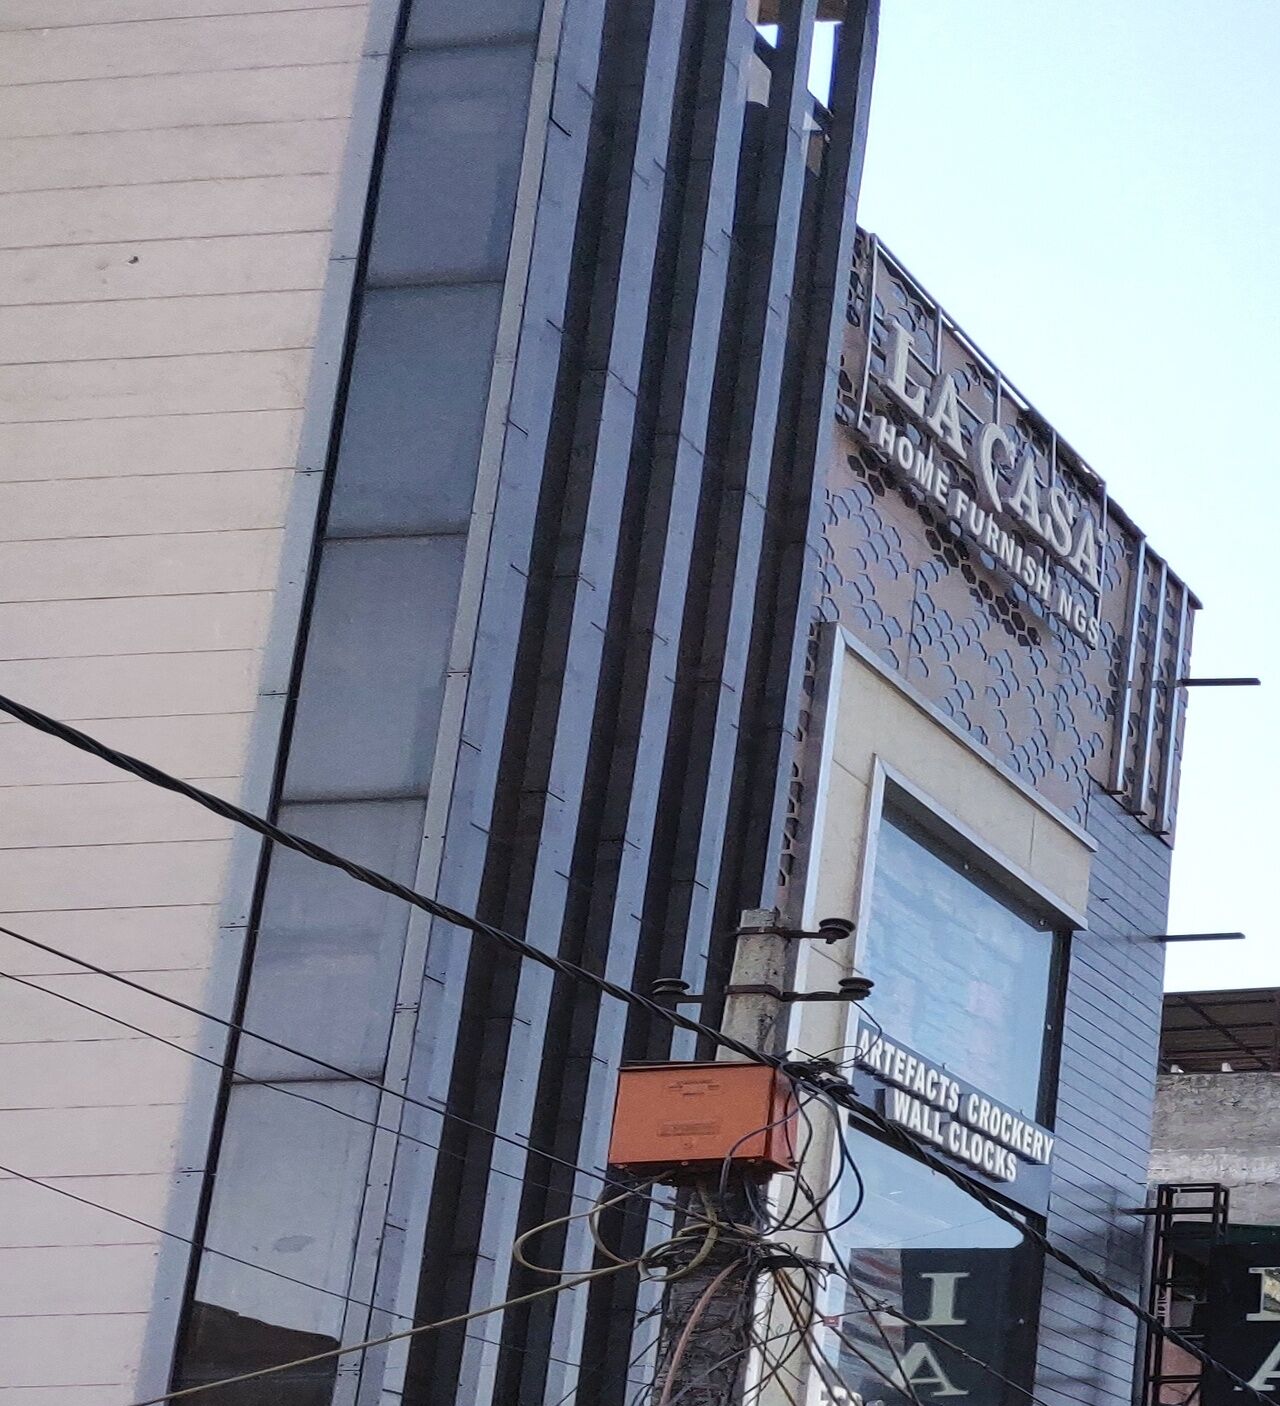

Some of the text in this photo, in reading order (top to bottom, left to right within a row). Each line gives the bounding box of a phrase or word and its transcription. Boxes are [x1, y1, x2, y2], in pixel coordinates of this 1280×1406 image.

[877, 424, 950, 506] HOME
[882, 318, 1106, 596] LA CASA
[858, 1028, 1055, 1166] ARTEFACTS CROCKERY
[892, 1088, 1018, 1183] WALL CLOCKS
